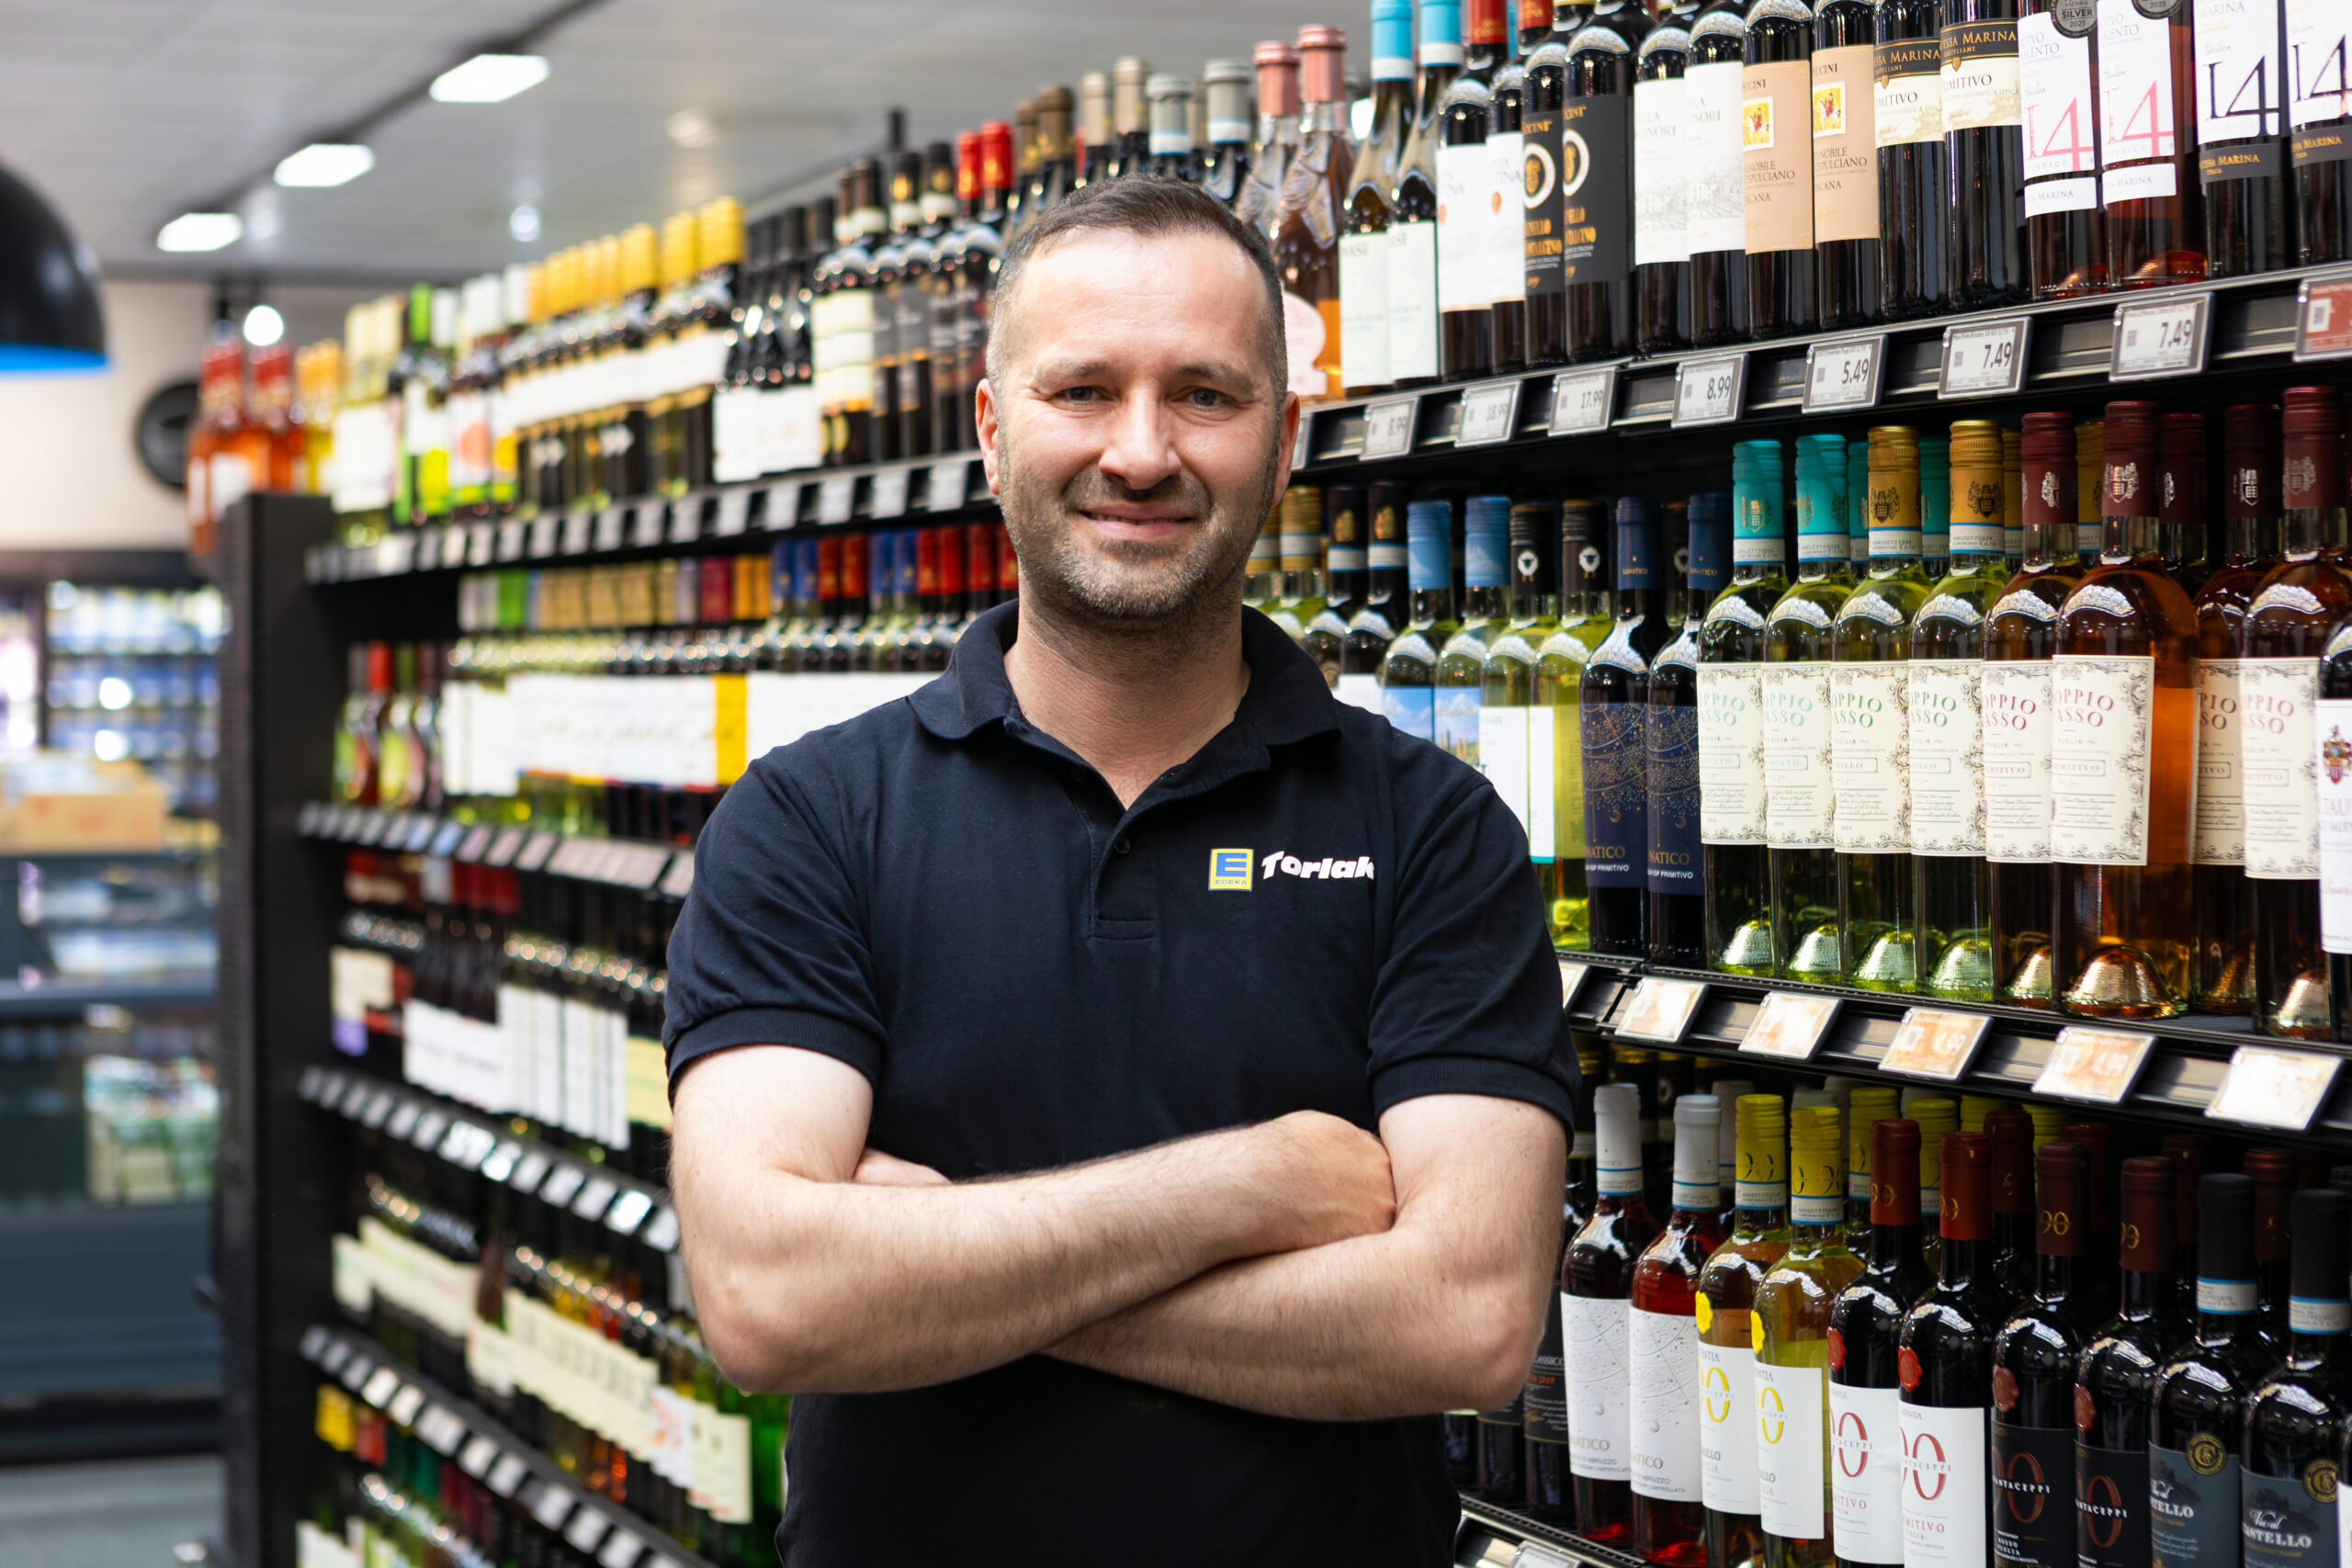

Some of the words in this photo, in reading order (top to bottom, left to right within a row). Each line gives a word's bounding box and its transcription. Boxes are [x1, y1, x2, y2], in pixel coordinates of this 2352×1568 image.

[2062, 6, 2093, 18] SILVER
[1962, 30, 2017, 45] MARINA
[1891, 50, 1940, 63] MARINA
[2302, 136, 2342, 149] MARINA
[2218, 154, 2260, 166] MARINA
[2160, 320, 2193, 348] 7.49
[1983, 342, 2012, 369] 7.49
[1842, 358, 1869, 385] 5.49
[1707, 375, 1731, 400] 8.99
[1580, 389, 1603, 410] 17.99
[1216, 852, 1248, 877] E
[1261, 851, 1374, 880] Torlak
[1660, 870, 1693, 879] PRIMITIVO
[1932, 1032, 1966, 1056] 4.99
